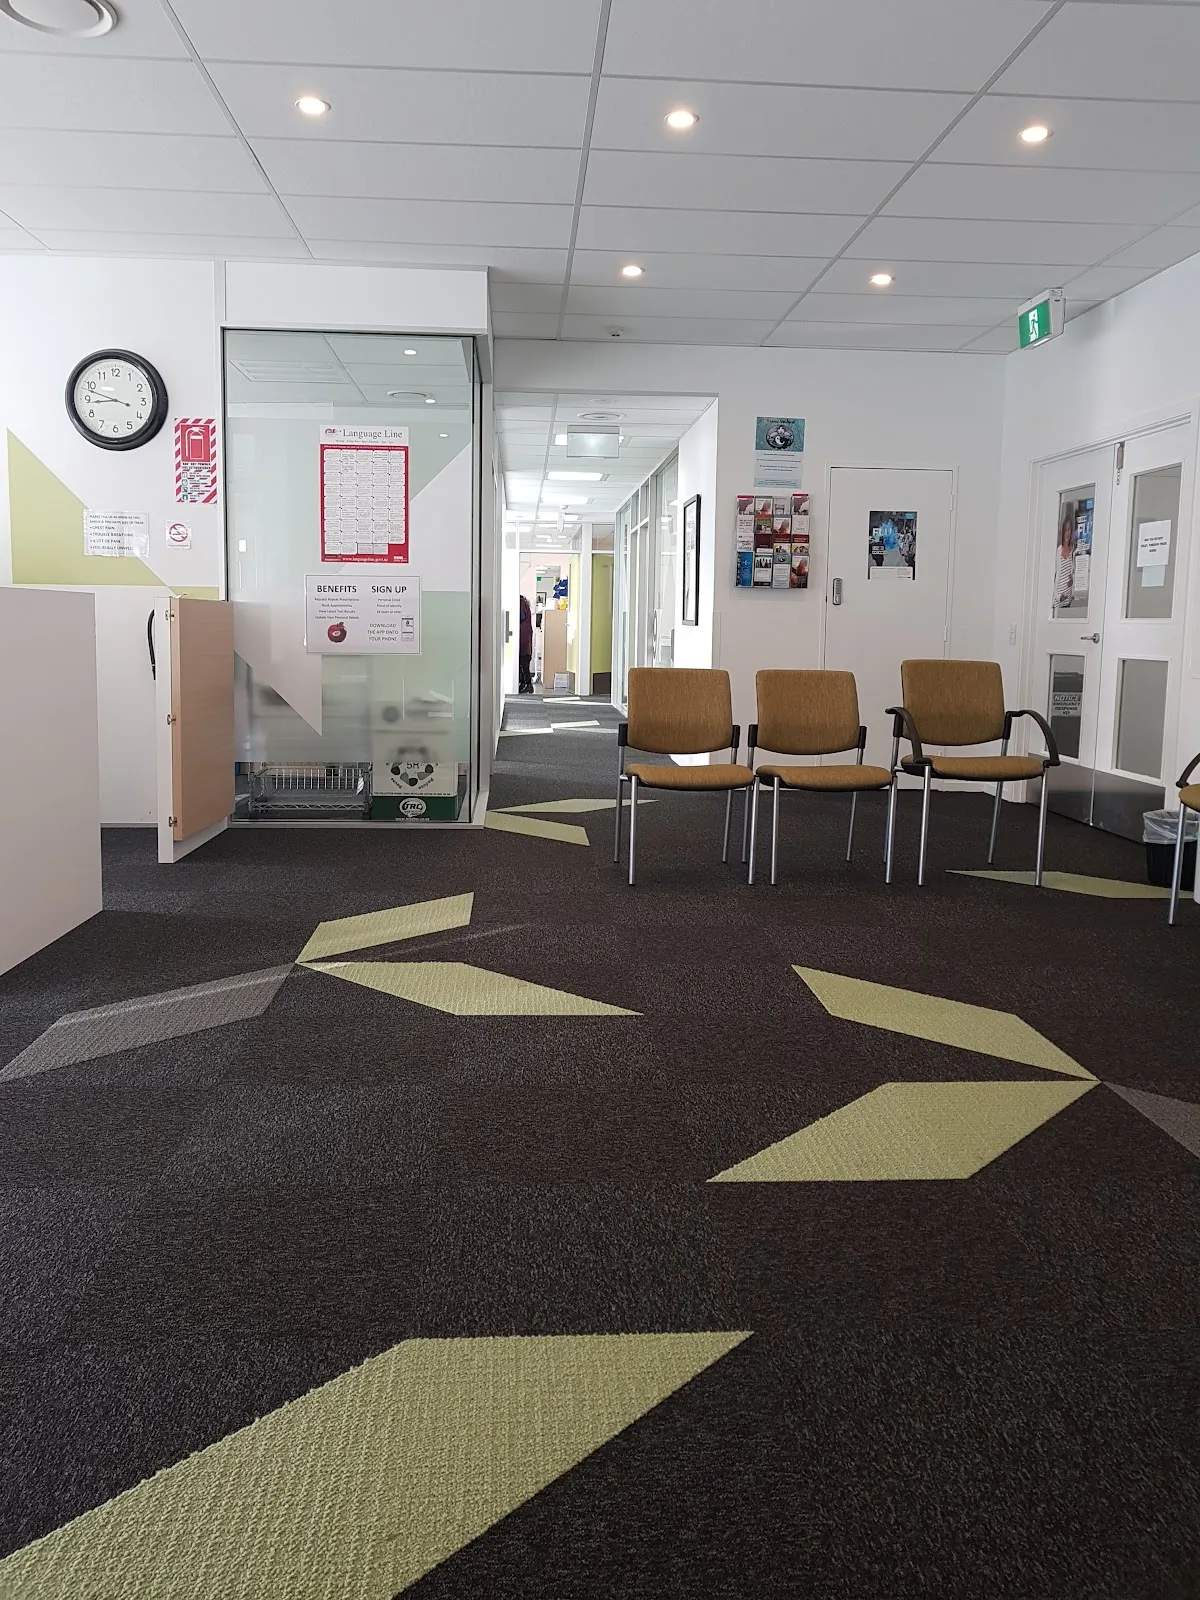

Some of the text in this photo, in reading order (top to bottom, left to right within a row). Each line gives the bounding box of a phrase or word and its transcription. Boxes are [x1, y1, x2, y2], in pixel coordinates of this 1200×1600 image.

[98, 371, 106, 381] 11
[111, 368, 121, 377] 12
[128, 372, 132, 382] 1
[87, 381, 97, 390] 10
[136, 383, 143, 392] 2
[84, 394, 91, 403] 9
[140, 397, 147, 406] 3
[88, 409, 95, 418] 8
[136, 411, 143, 420] 4
[98, 419, 105, 431] 7
[112, 424, 119, 433] 6
[126, 421, 133, 430] 5
[343, 429, 382, 439] Language
[384, 429, 403, 438] Line
[317, 585, 357, 593] BENEFITS
[371, 585, 407, 594] SIGN UP
